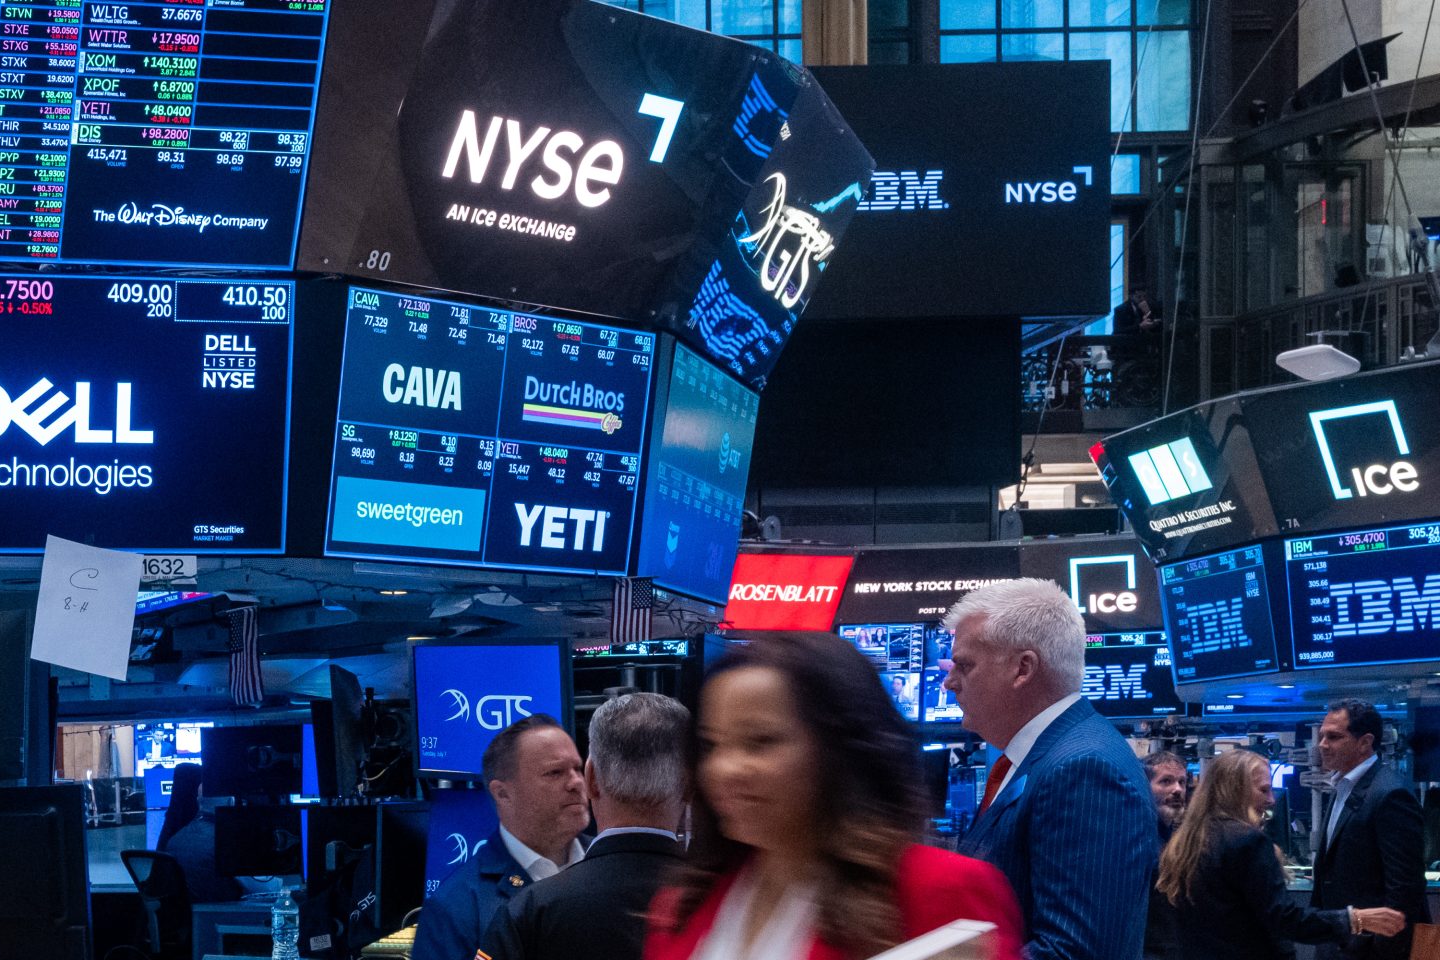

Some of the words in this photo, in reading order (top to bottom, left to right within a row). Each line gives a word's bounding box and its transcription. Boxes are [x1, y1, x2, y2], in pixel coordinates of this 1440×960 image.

[92, 5, 128, 19] WLTG
[162, 9, 202, 22] 37.6676
[89, 29, 127, 43] WTTR
[160, 34, 200, 46] 17.9500
[86, 54, 116, 68] XOM
[150, 57, 196, 70] 140.3100
[84, 78, 120, 92] XPOF
[160, 81, 194, 93] 6.8700
[82, 102, 110, 115] YETI
[151, 105, 192, 116] 48.0400
[80, 126, 101, 138] DIS
[87, 148, 127, 162] 415,471
[158, 152, 184, 162] 98.31
[216, 154, 244, 164] 98.69
[275, 156, 302, 167] 97.99
[93, 210, 115, 222] The
[213, 215, 268, 230] Company
[446, 203, 470, 222] AN
[108, 284, 172, 304] 409.00
[222, 286, 287, 306] 410.50
[355, 292, 380, 307] CAVA
[403, 298, 430, 312] 72.1300
[147, 304, 172, 318] 200
[262, 306, 286, 320] 100
[514, 316, 537, 330] BROS
[556, 322, 582, 336] 67.8650
[205, 334, 256, 352] DELL
[204, 358, 256, 368] LISTED
[202, 372, 255, 389] NYSE
[382, 363, 462, 411] CAVA
[342, 424, 355, 438] SG
[501, 442, 519, 455] YETI
[356, 500, 463, 528] sweetgreen
[1150, 514, 1179, 532] QUATTRO
[1179, 512, 1187, 524] M
[1186, 504, 1221, 522] SECURITIES
[194, 525, 210, 534] GTS
[212, 525, 244, 534] Securities
[514, 502, 607, 552] YETI
[1286, 518, 1300, 528] 7A
[1292, 540, 1312, 554] IBM
[1408, 526, 1440, 539] 305.24
[142, 558, 184, 575] 1632
[729, 584, 838, 603] ROSENBLATT
[854, 582, 882, 594] NEW
[883, 582, 912, 593] YORK
[915, 580, 952, 592] STOCK
[1330, 574, 1440, 637] IBM
[422, 736, 438, 749] 9:37
[357, 892, 377, 910] GTS
